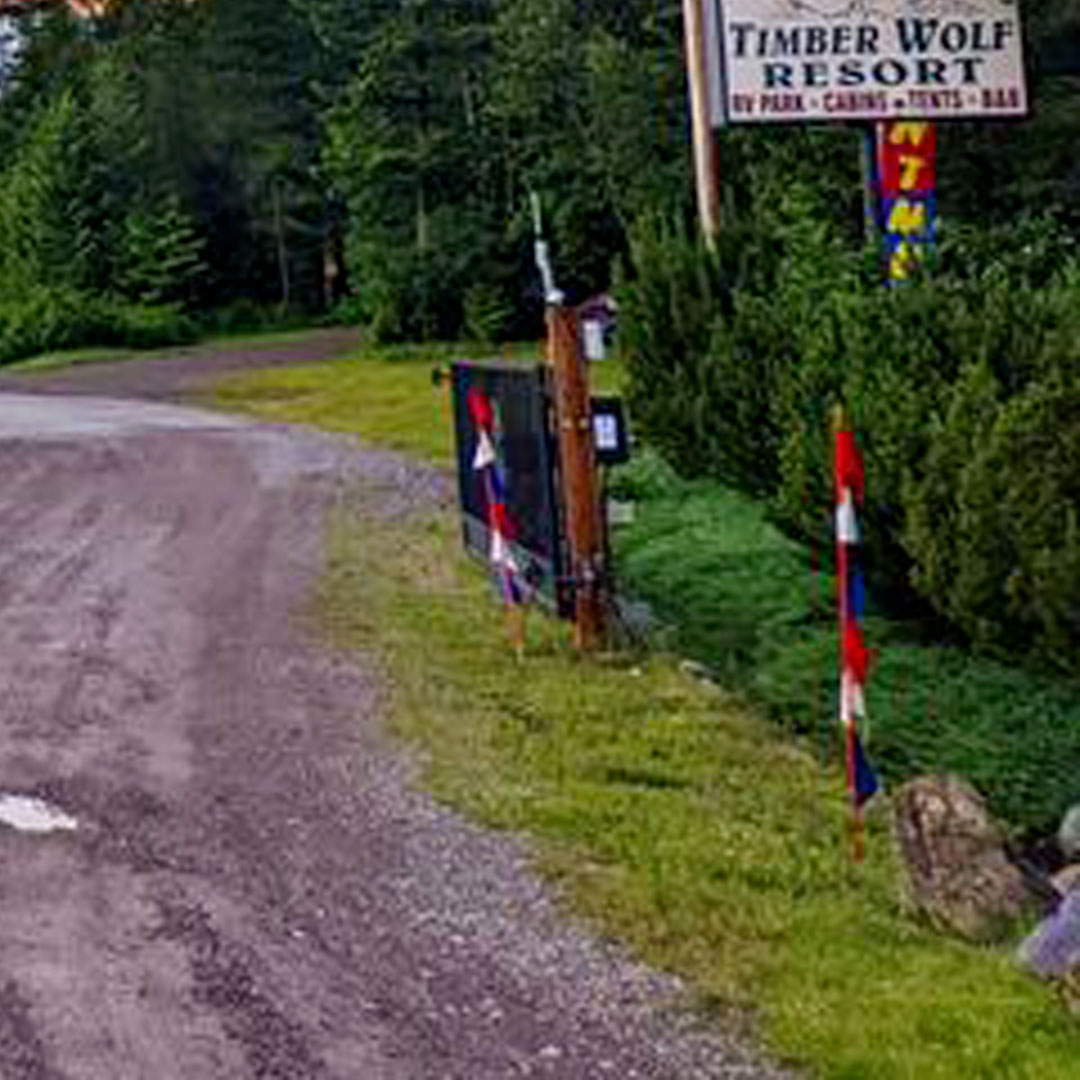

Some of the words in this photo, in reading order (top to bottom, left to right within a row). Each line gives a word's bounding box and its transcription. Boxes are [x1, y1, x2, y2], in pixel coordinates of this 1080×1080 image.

[729, 23, 880, 57] TIMBER
[896, 17, 1013, 54] WOLF
[763, 58, 985, 88] RESORT
[759, 91, 808, 113] PARK
